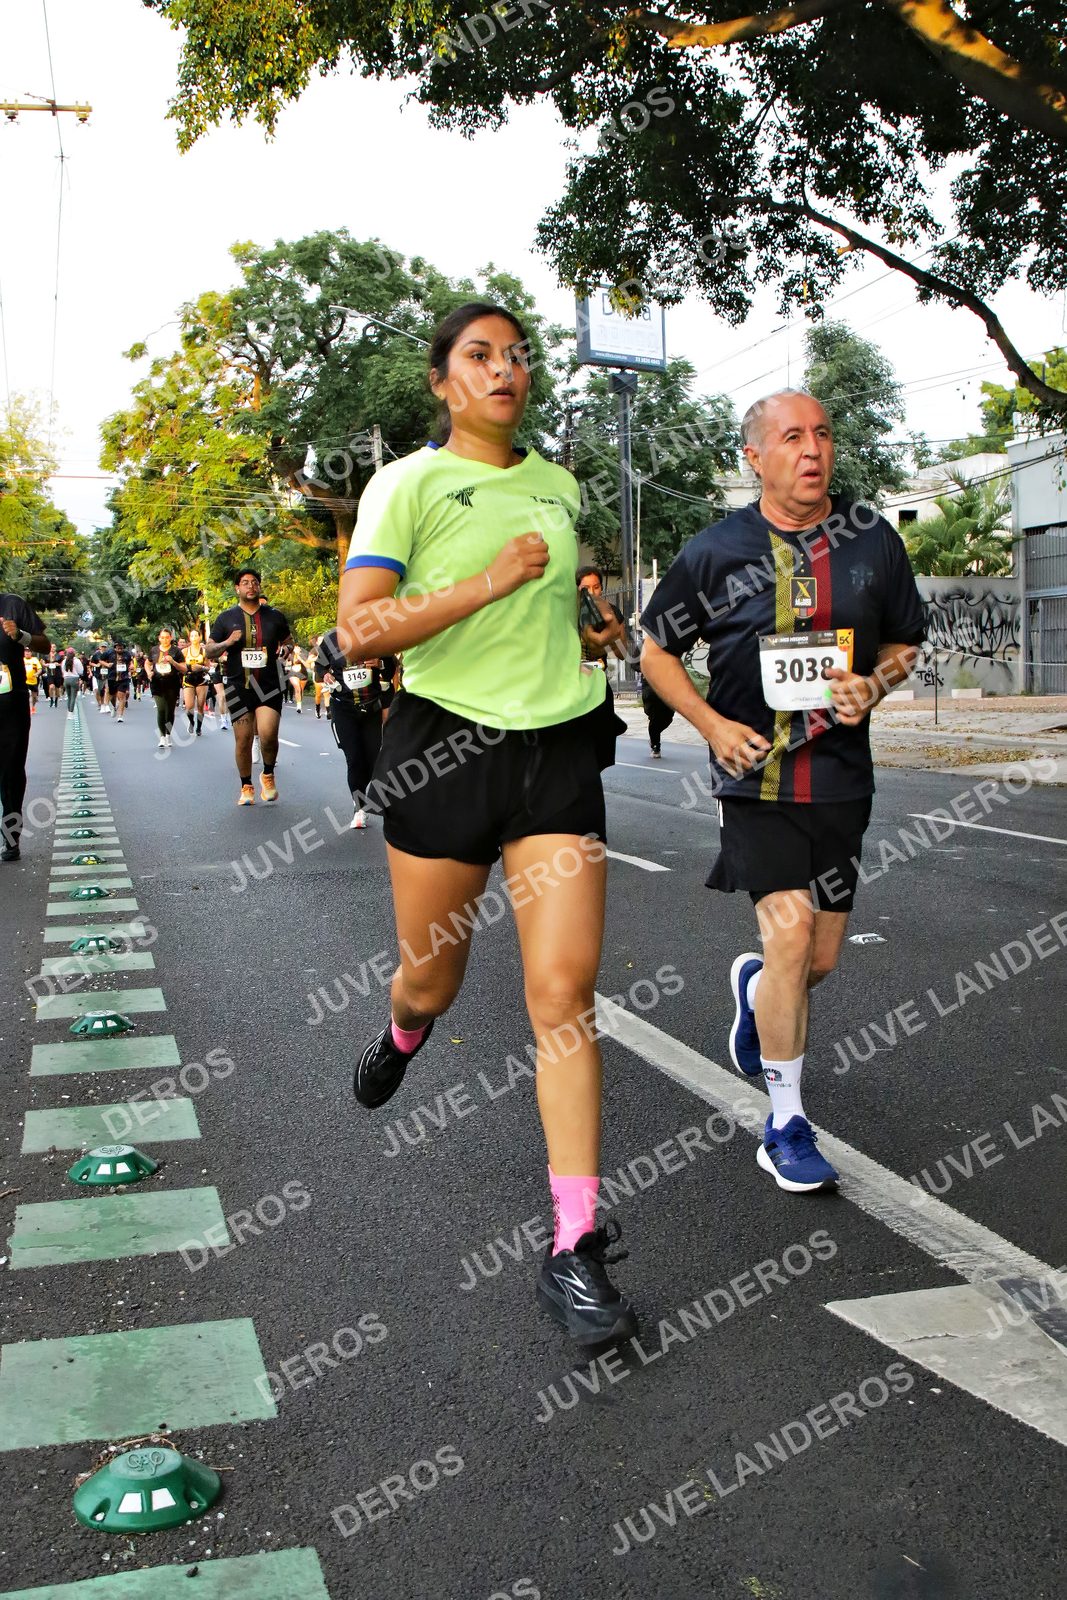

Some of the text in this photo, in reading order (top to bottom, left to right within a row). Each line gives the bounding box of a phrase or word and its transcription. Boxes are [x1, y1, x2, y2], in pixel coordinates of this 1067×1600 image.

[839, 636, 850, 645] 5K
[245, 653, 263, 661] 1735
[774, 656, 835, 684] 3038
[347, 671, 367, 681] 3145
